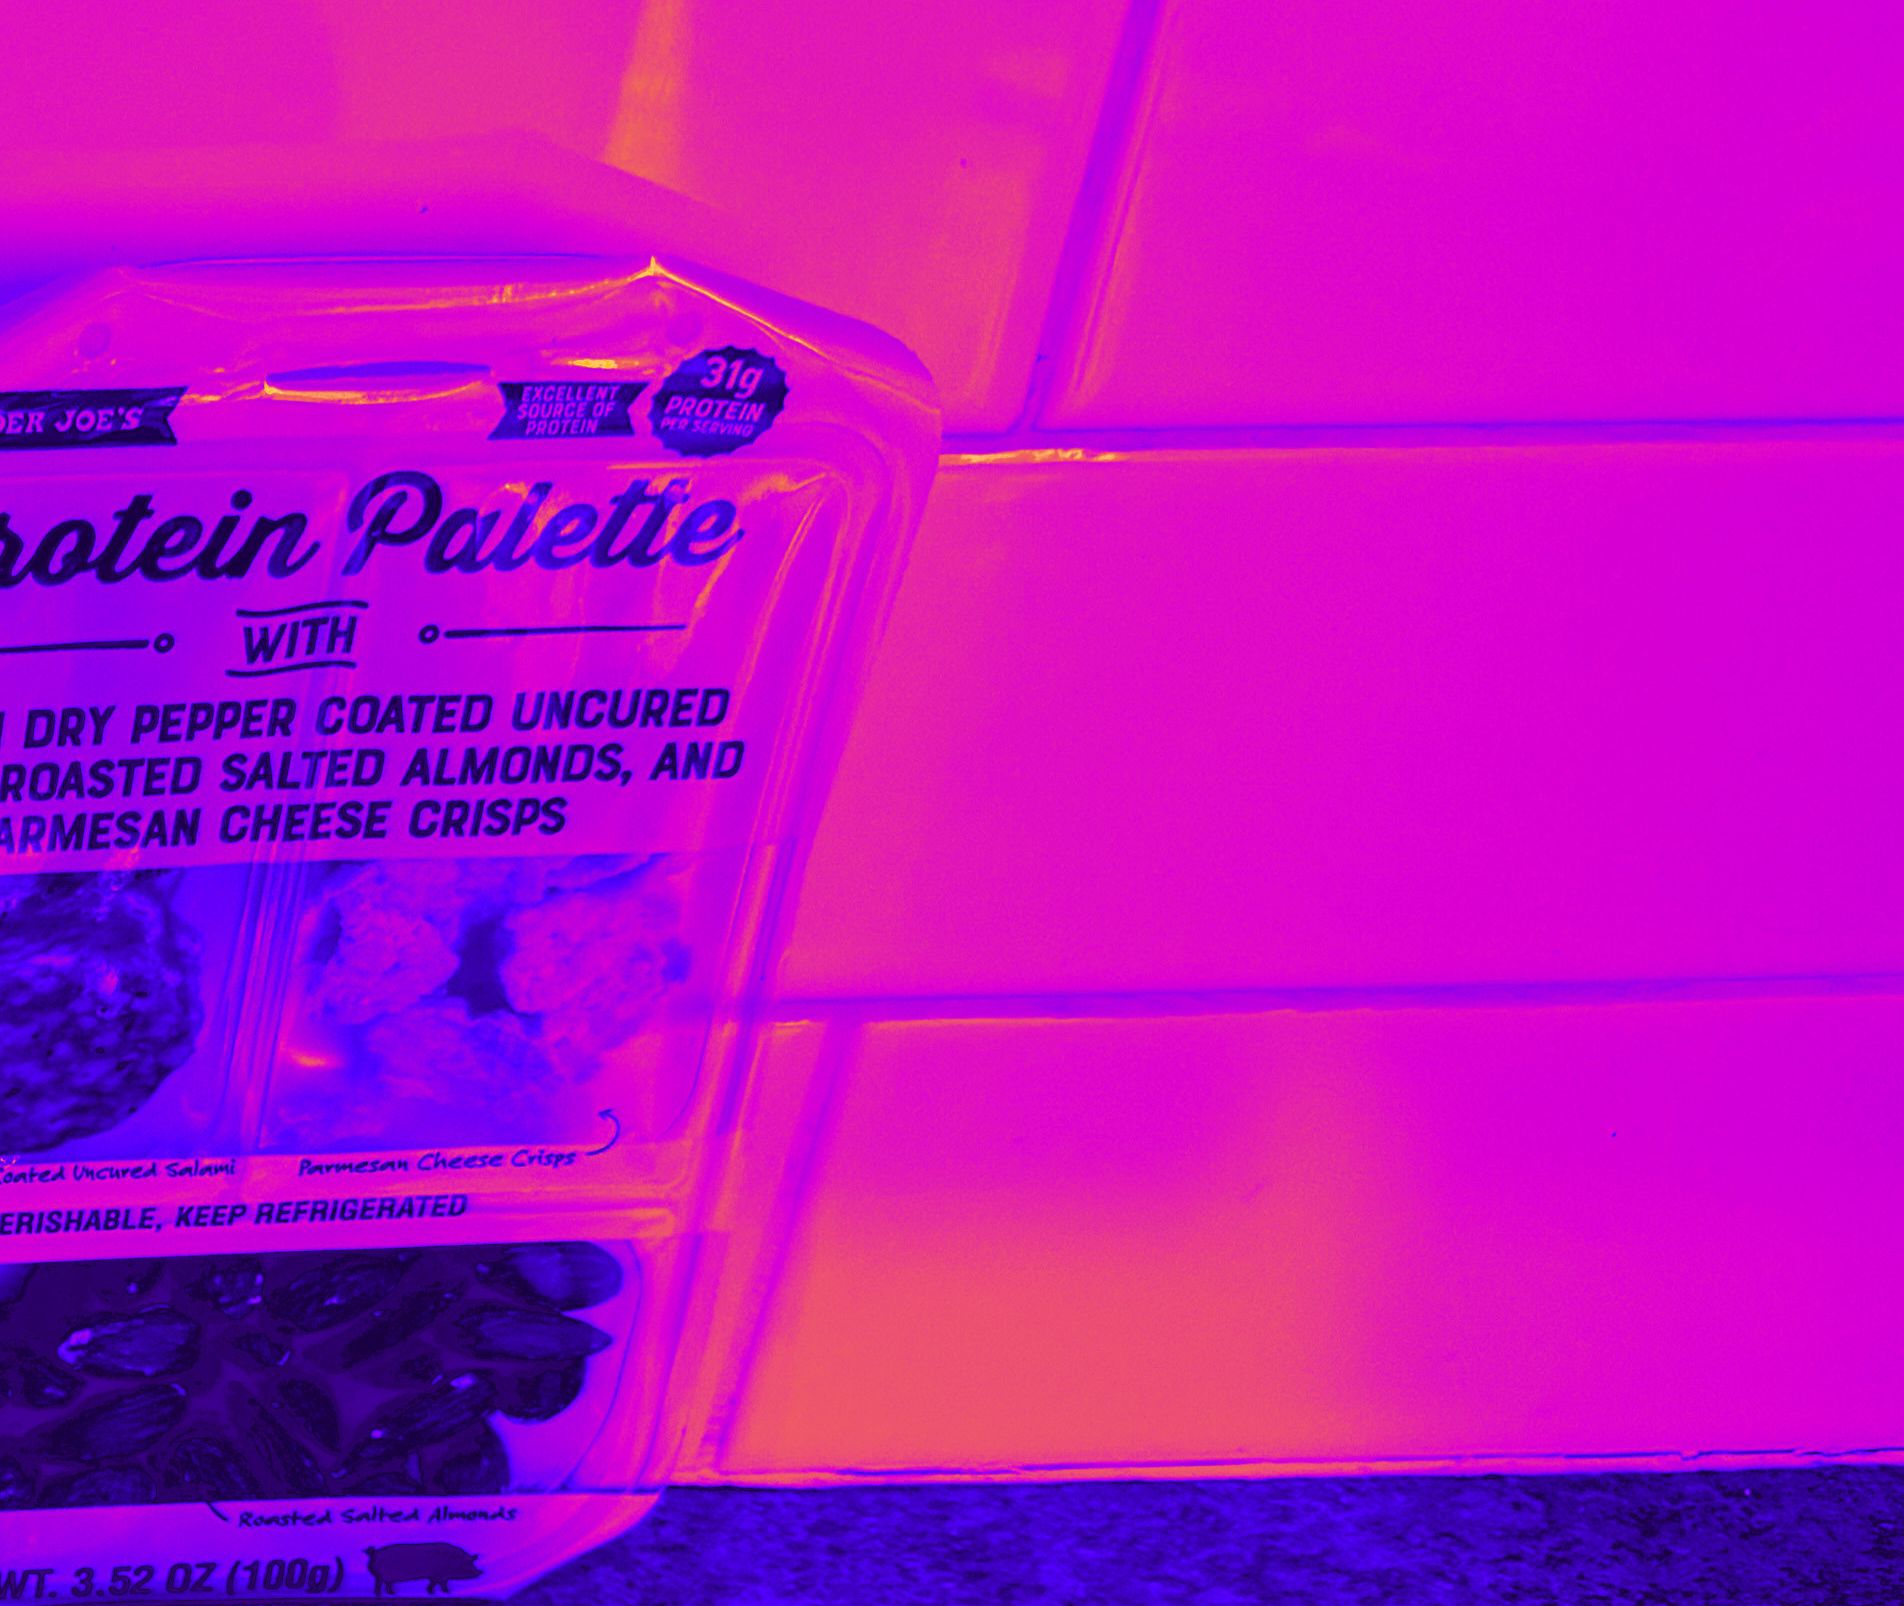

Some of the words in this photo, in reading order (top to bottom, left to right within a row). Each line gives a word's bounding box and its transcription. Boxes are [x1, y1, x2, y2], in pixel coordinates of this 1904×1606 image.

[521, 385, 621, 401] EXCELLENT
[699, 356, 765, 399] 31g
[54, 405, 145, 433] JOE'S
[518, 402, 586, 420] SOURCE
[664, 395, 767, 422] PROTEIN
[525, 418, 598, 436] PROTEIN
[339, 467, 750, 577] Palette
[239, 614, 361, 667] WITH
[25, 704, 115, 752] DRY
[129, 698, 298, 746] PEPPER
[314, 692, 496, 738] COATED
[511, 684, 733, 734] UNCURED
[218, 748, 386, 795] SALTED
[399, 742, 634, 794] ALMONDS,
[649, 736, 749, 782] AND
[217, 805, 393, 847] CHEESE
[408, 797, 572, 839] CRISPS
[72, 1161, 159, 1182] Uncured
[164, 1158, 237, 1179] Salami
[298, 1156, 409, 1177] Parmesan
[416, 1151, 504, 1172] Cheese
[510, 1148, 578, 1169] Crisps
[174, 1203, 248, 1228] KEEP
[254, 1193, 470, 1226] REFRIGERATED
[238, 1510, 333, 1529] Roasted
[341, 1505, 420, 1524] Salted
[71, 1566, 156, 1598] 3.52
[166, 1561, 218, 1594] OZ
[226, 1556, 346, 1597] (100g)
